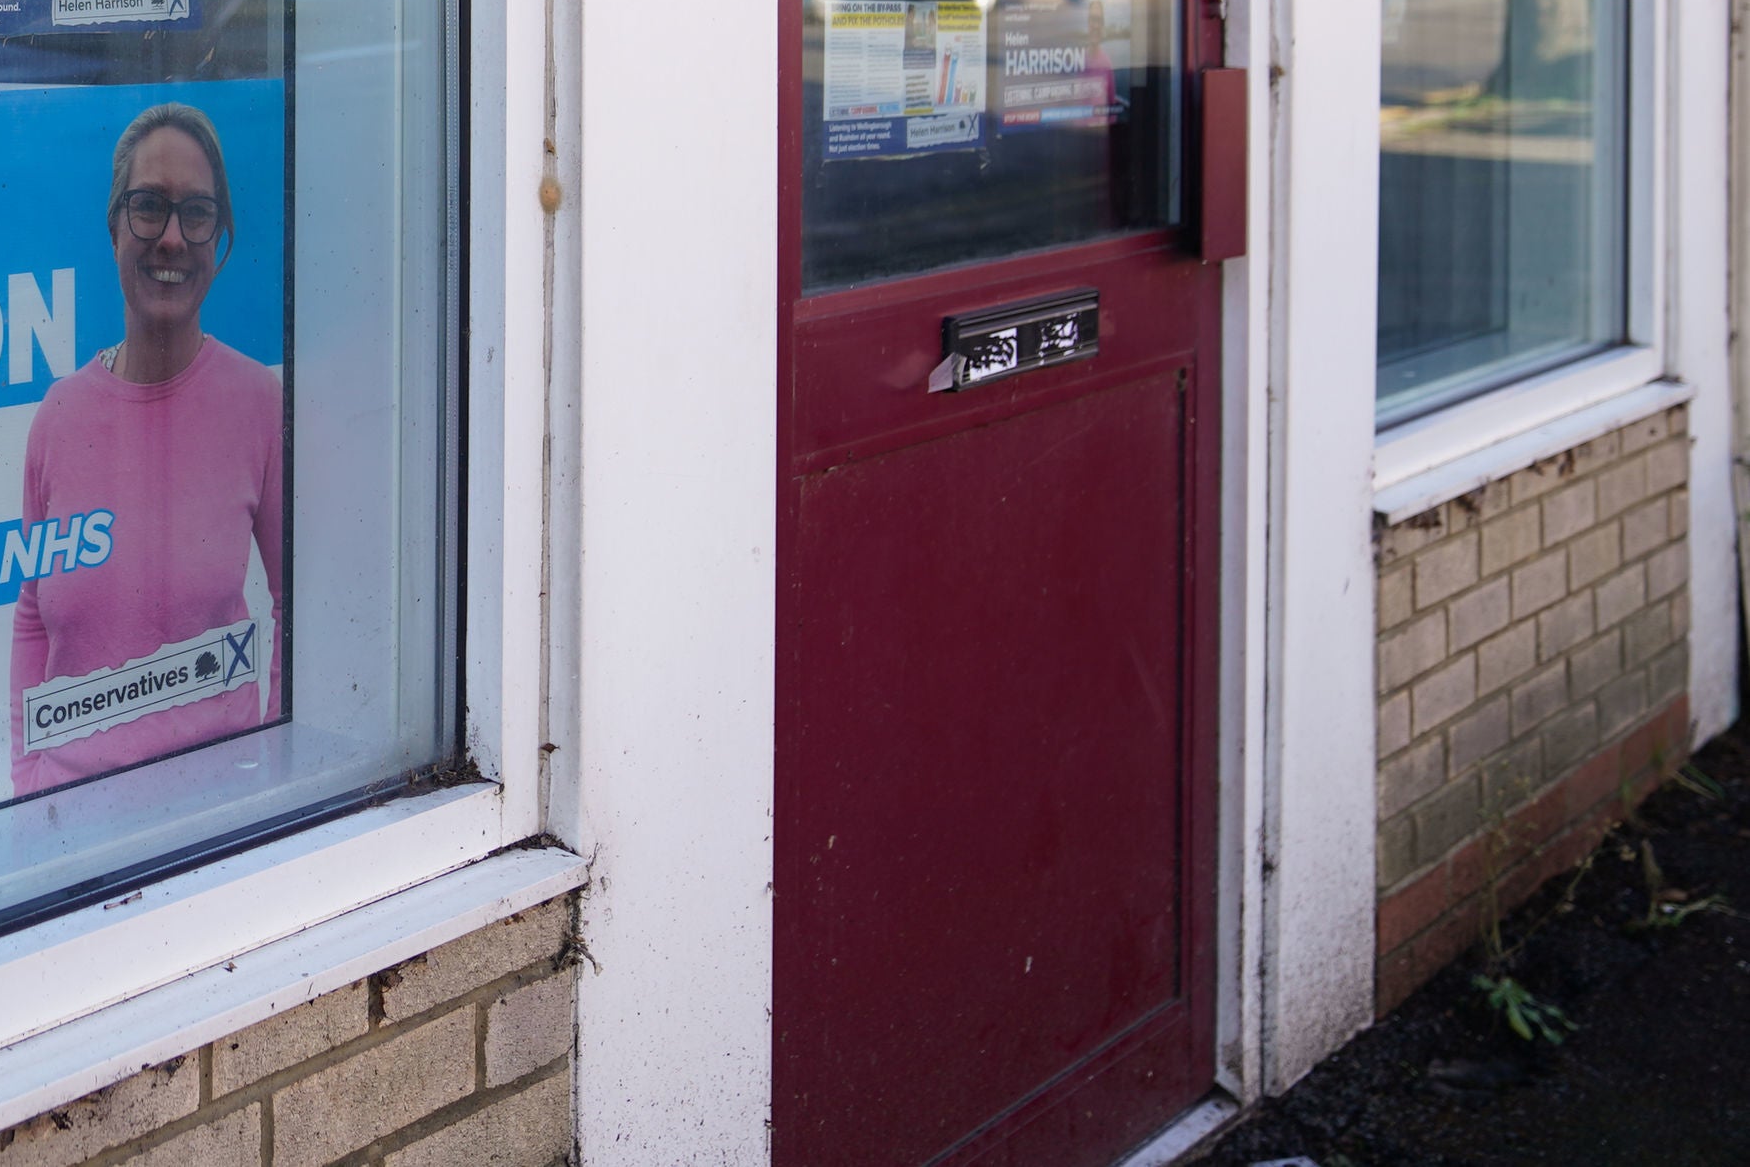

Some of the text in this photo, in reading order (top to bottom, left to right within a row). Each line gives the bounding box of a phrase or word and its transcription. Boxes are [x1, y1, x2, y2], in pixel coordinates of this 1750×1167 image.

[1005, 32, 1028, 46] Helen
[1006, 47, 1086, 76] HARRISON
[0, 508, 114, 587] NHS
[35, 665, 189, 729] Conservatives
